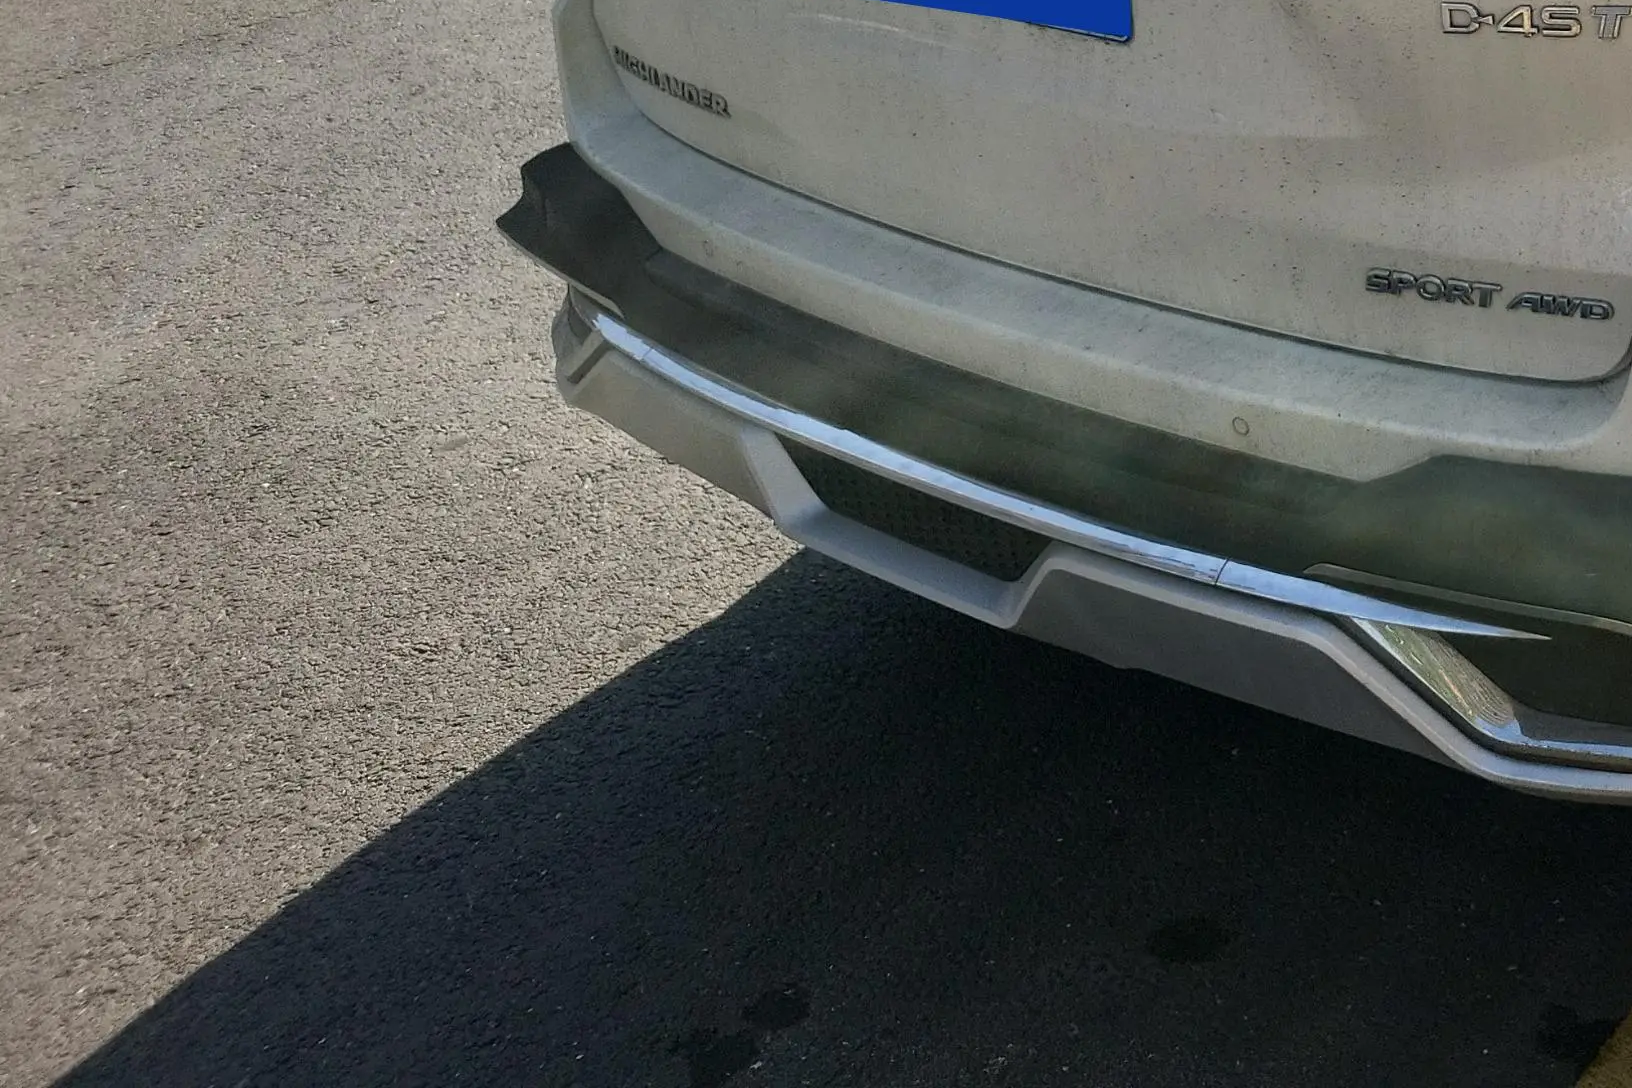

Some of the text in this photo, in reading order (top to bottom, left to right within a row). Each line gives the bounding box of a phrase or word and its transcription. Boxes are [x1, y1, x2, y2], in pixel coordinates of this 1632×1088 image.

[612, 44, 732, 119] HIGHLANDER
[1364, 267, 1616, 321] SPORT AWD
